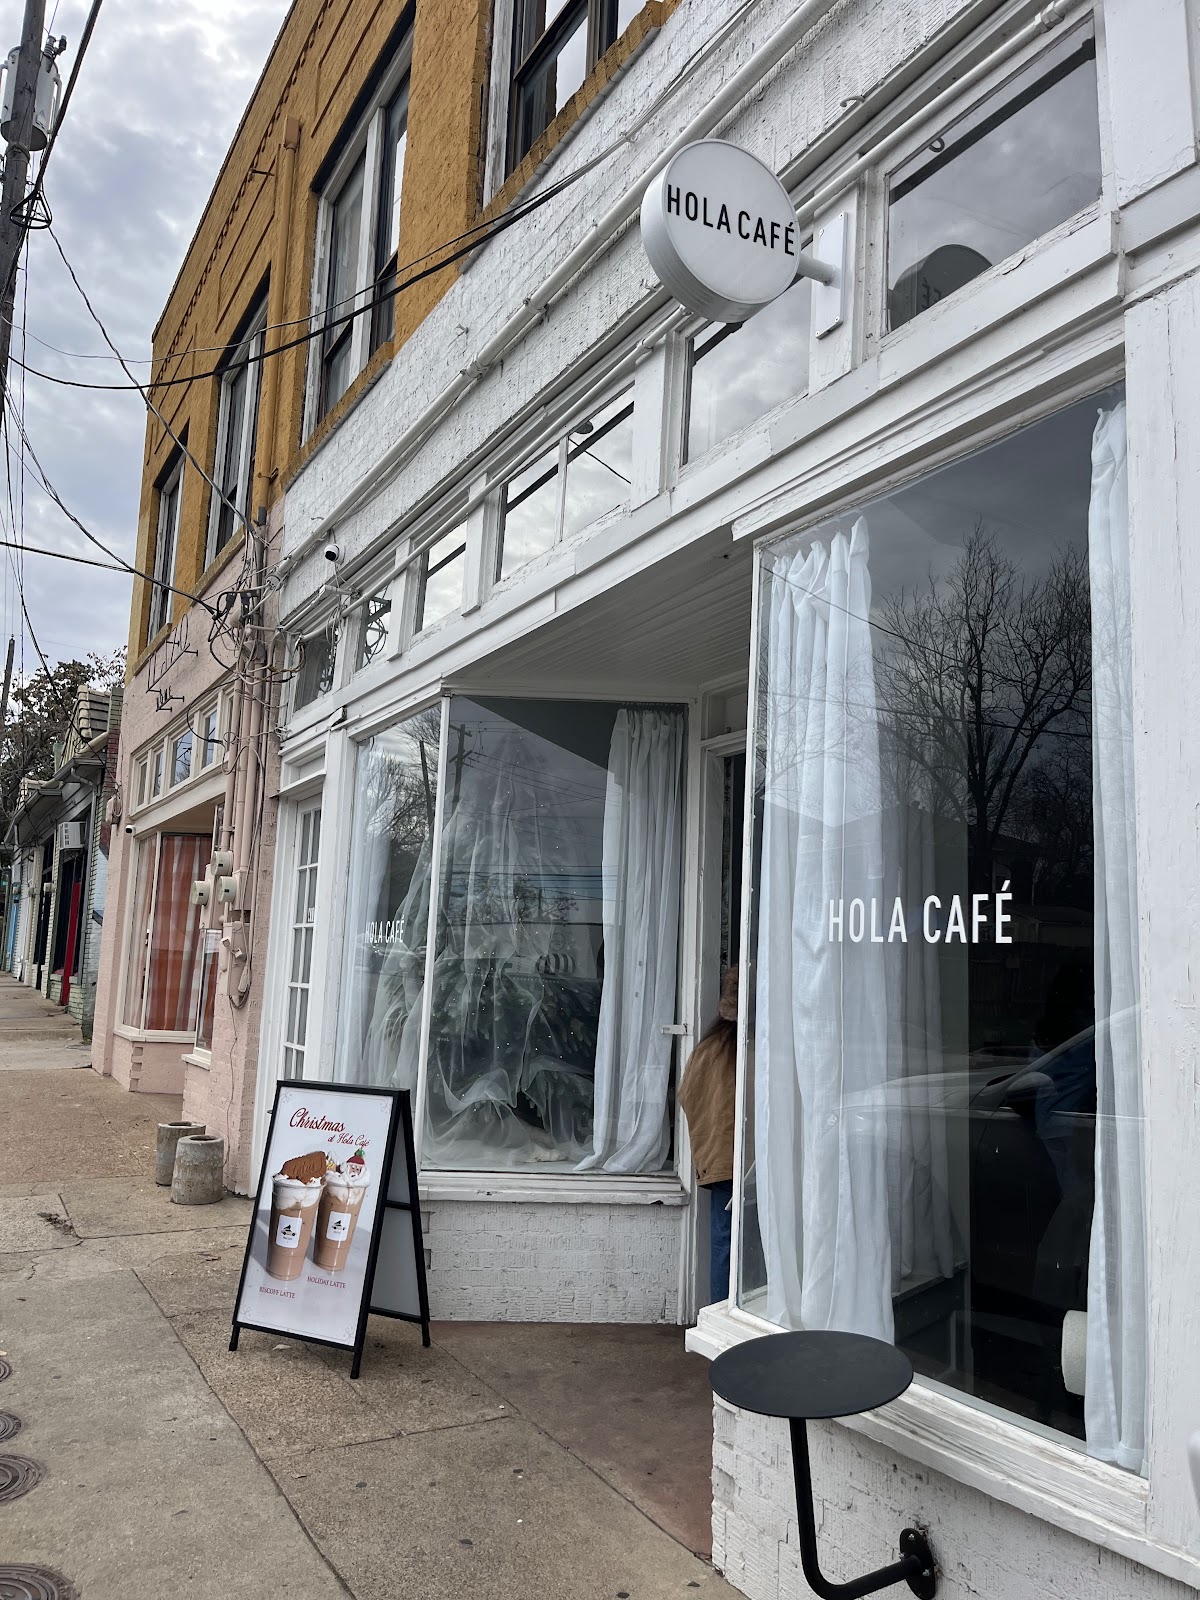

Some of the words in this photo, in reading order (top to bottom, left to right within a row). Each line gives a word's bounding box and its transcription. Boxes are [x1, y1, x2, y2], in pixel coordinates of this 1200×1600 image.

[667, 183, 731, 234] HOLA
[737, 210, 795, 256] CAFÉ
[828, 897, 908, 943] HOLA
[923, 879, 1013, 944] CAFÉ
[364, 921, 383, 944] HOLA
[385, 914, 405, 944] CAFÉ
[289, 1107, 346, 1132] Christmas
[337, 1132, 354, 1145] Hola
[259, 1286, 280, 1296] BISCOFF
[279, 1290, 296, 1299] LATTE
[307, 1275, 330, 1286] HOLIDAY
[329, 1280, 346, 1289] LATTE
